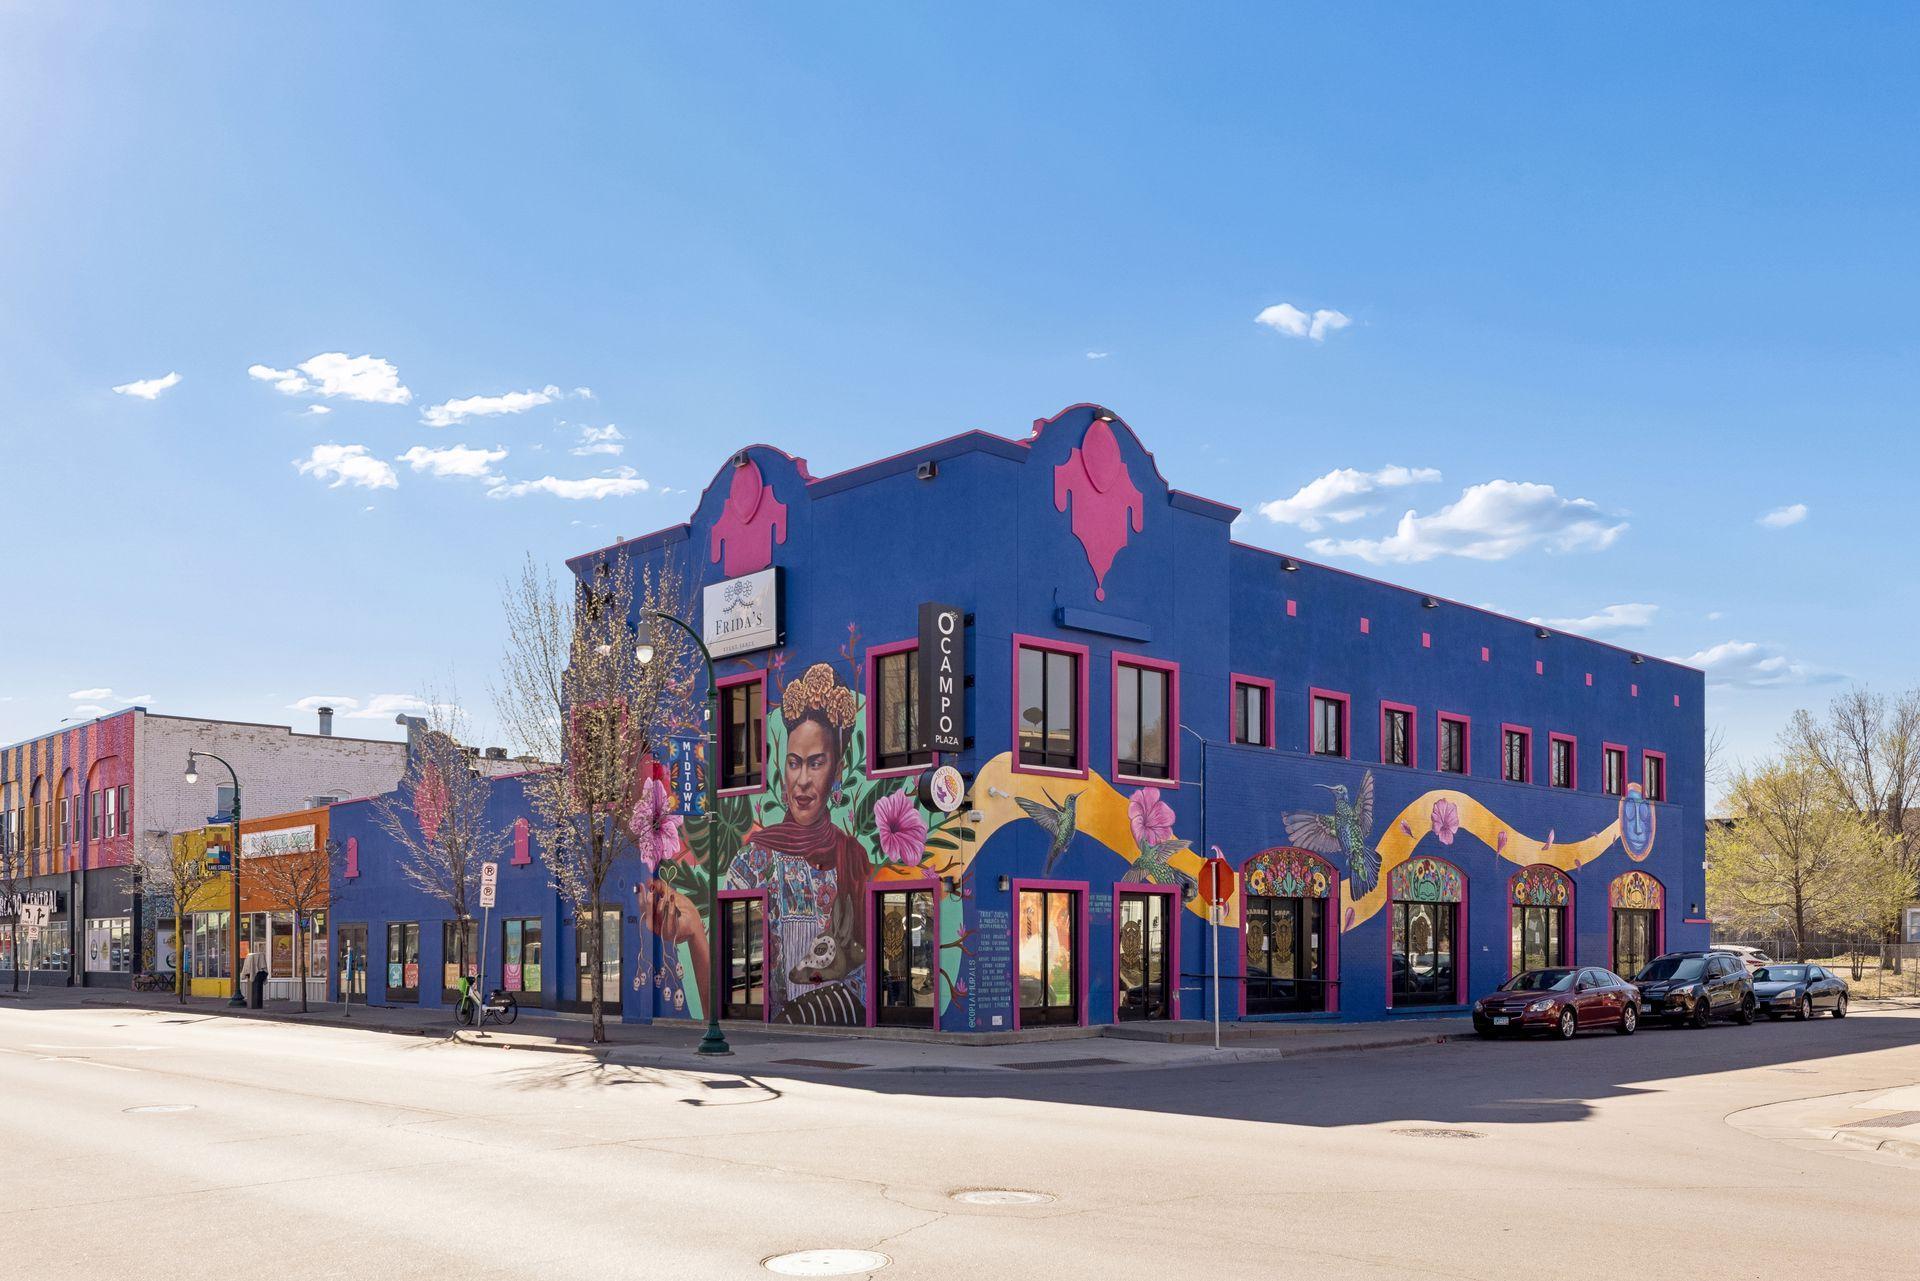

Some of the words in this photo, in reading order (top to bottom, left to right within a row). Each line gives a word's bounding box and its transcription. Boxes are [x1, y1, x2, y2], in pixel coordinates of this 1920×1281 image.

[716, 611, 762, 635] FRIDA'S
[938, 612, 954, 733] OCAMPO
[935, 734, 959, 745] PLAZA
[682, 741, 693, 812] MIDTOWN
